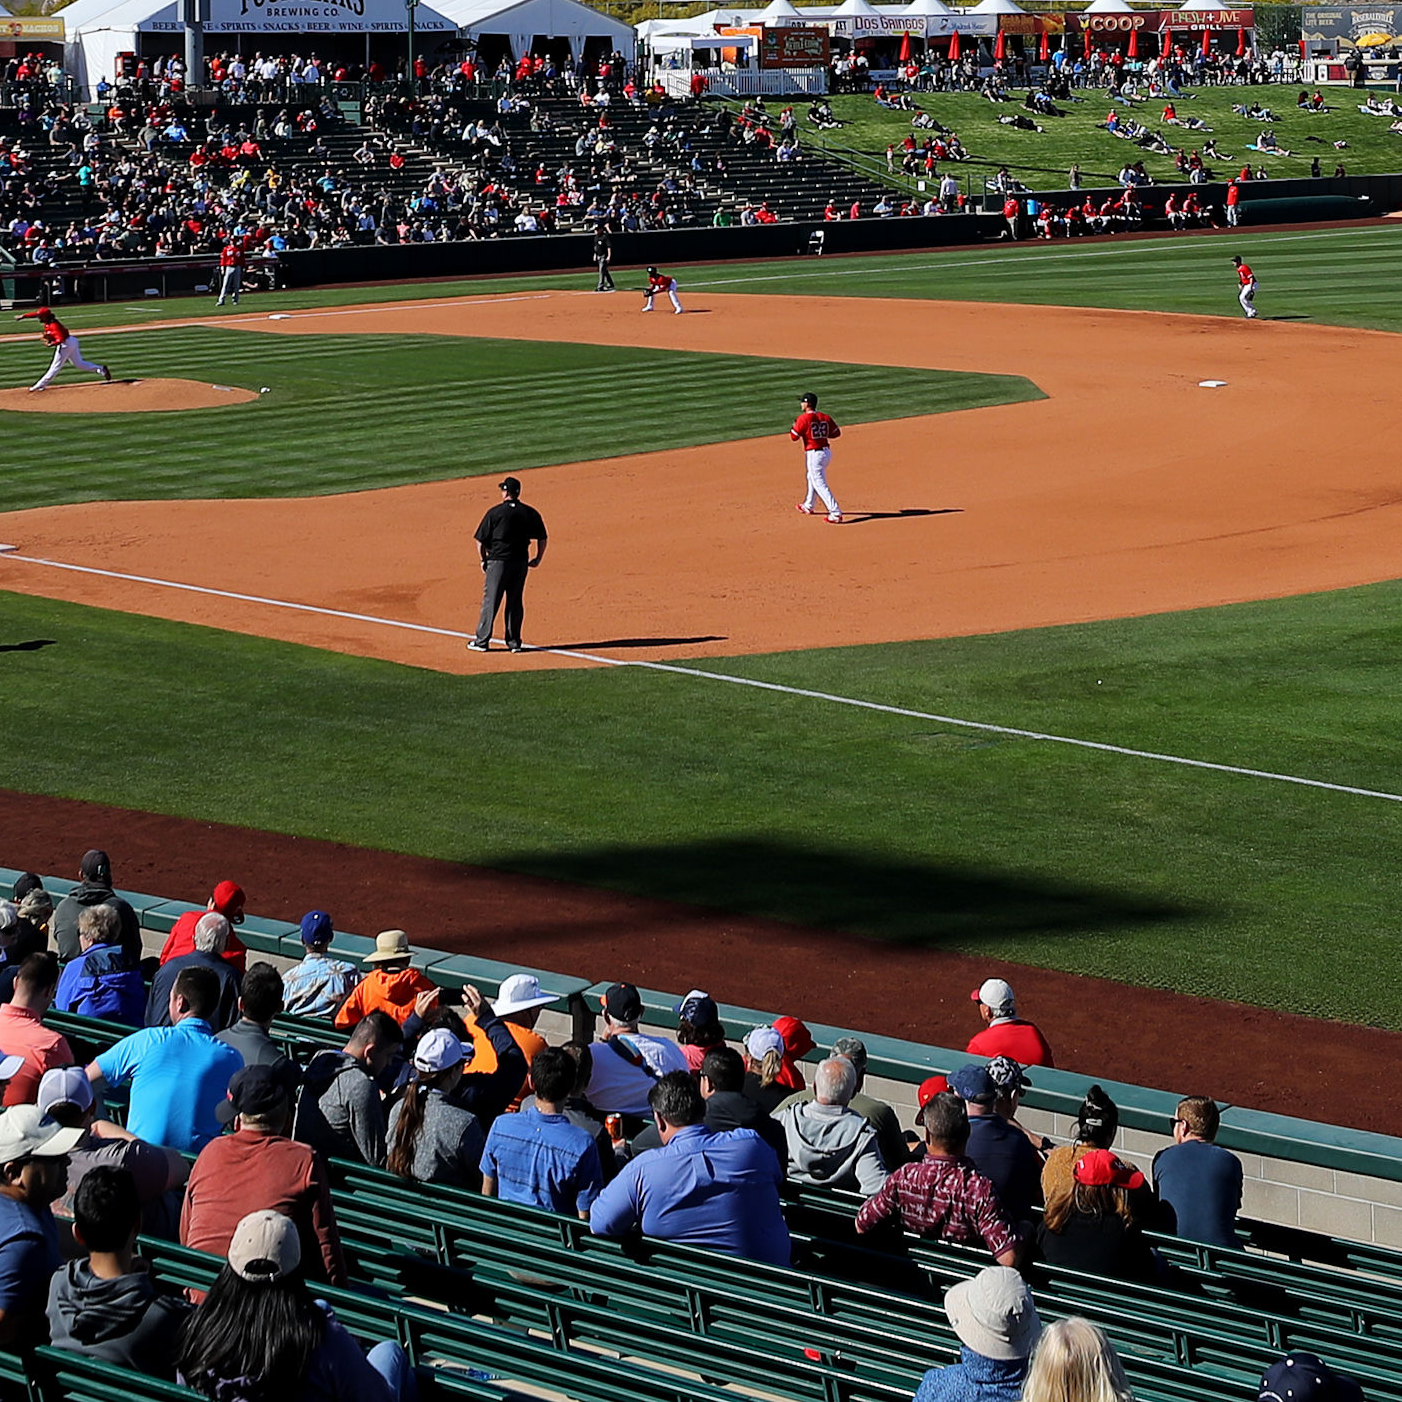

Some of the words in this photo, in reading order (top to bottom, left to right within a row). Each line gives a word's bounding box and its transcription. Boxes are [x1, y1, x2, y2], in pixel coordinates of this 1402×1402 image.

[266, 7, 319, 17] BREWING
[152, 22, 178, 31] BEER
[221, 21, 257, 31] SPIRITS
[263, 22, 300, 31] SNACKS
[307, 22, 331, 31] BEER
[339, 22, 364, 31] WINE
[371, 21, 404, 31] SPIRITS
[413, 21, 445, 30] NACKS
[855, 16, 879, 30] DOS
[880, 16, 925, 30] GRINGOS
[1090, 15, 1145, 31] COOP
